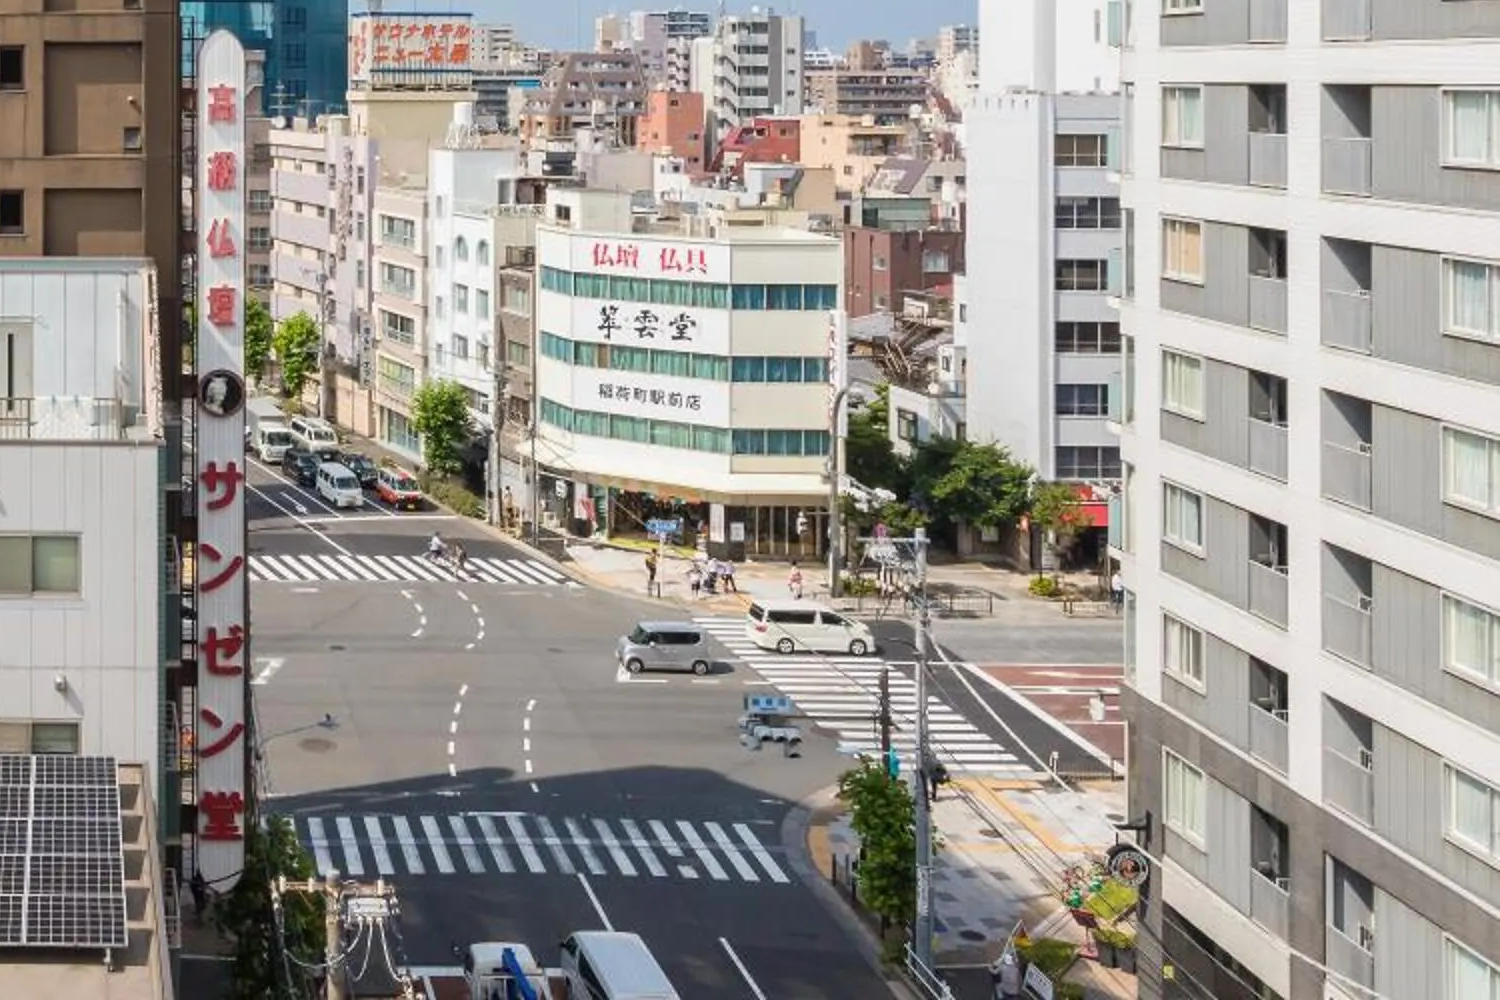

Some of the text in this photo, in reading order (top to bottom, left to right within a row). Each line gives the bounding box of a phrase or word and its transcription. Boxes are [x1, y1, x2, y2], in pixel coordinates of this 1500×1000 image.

[660, 247, 707, 274] 仏具
[200, 461, 243, 841] サンゼン堂
